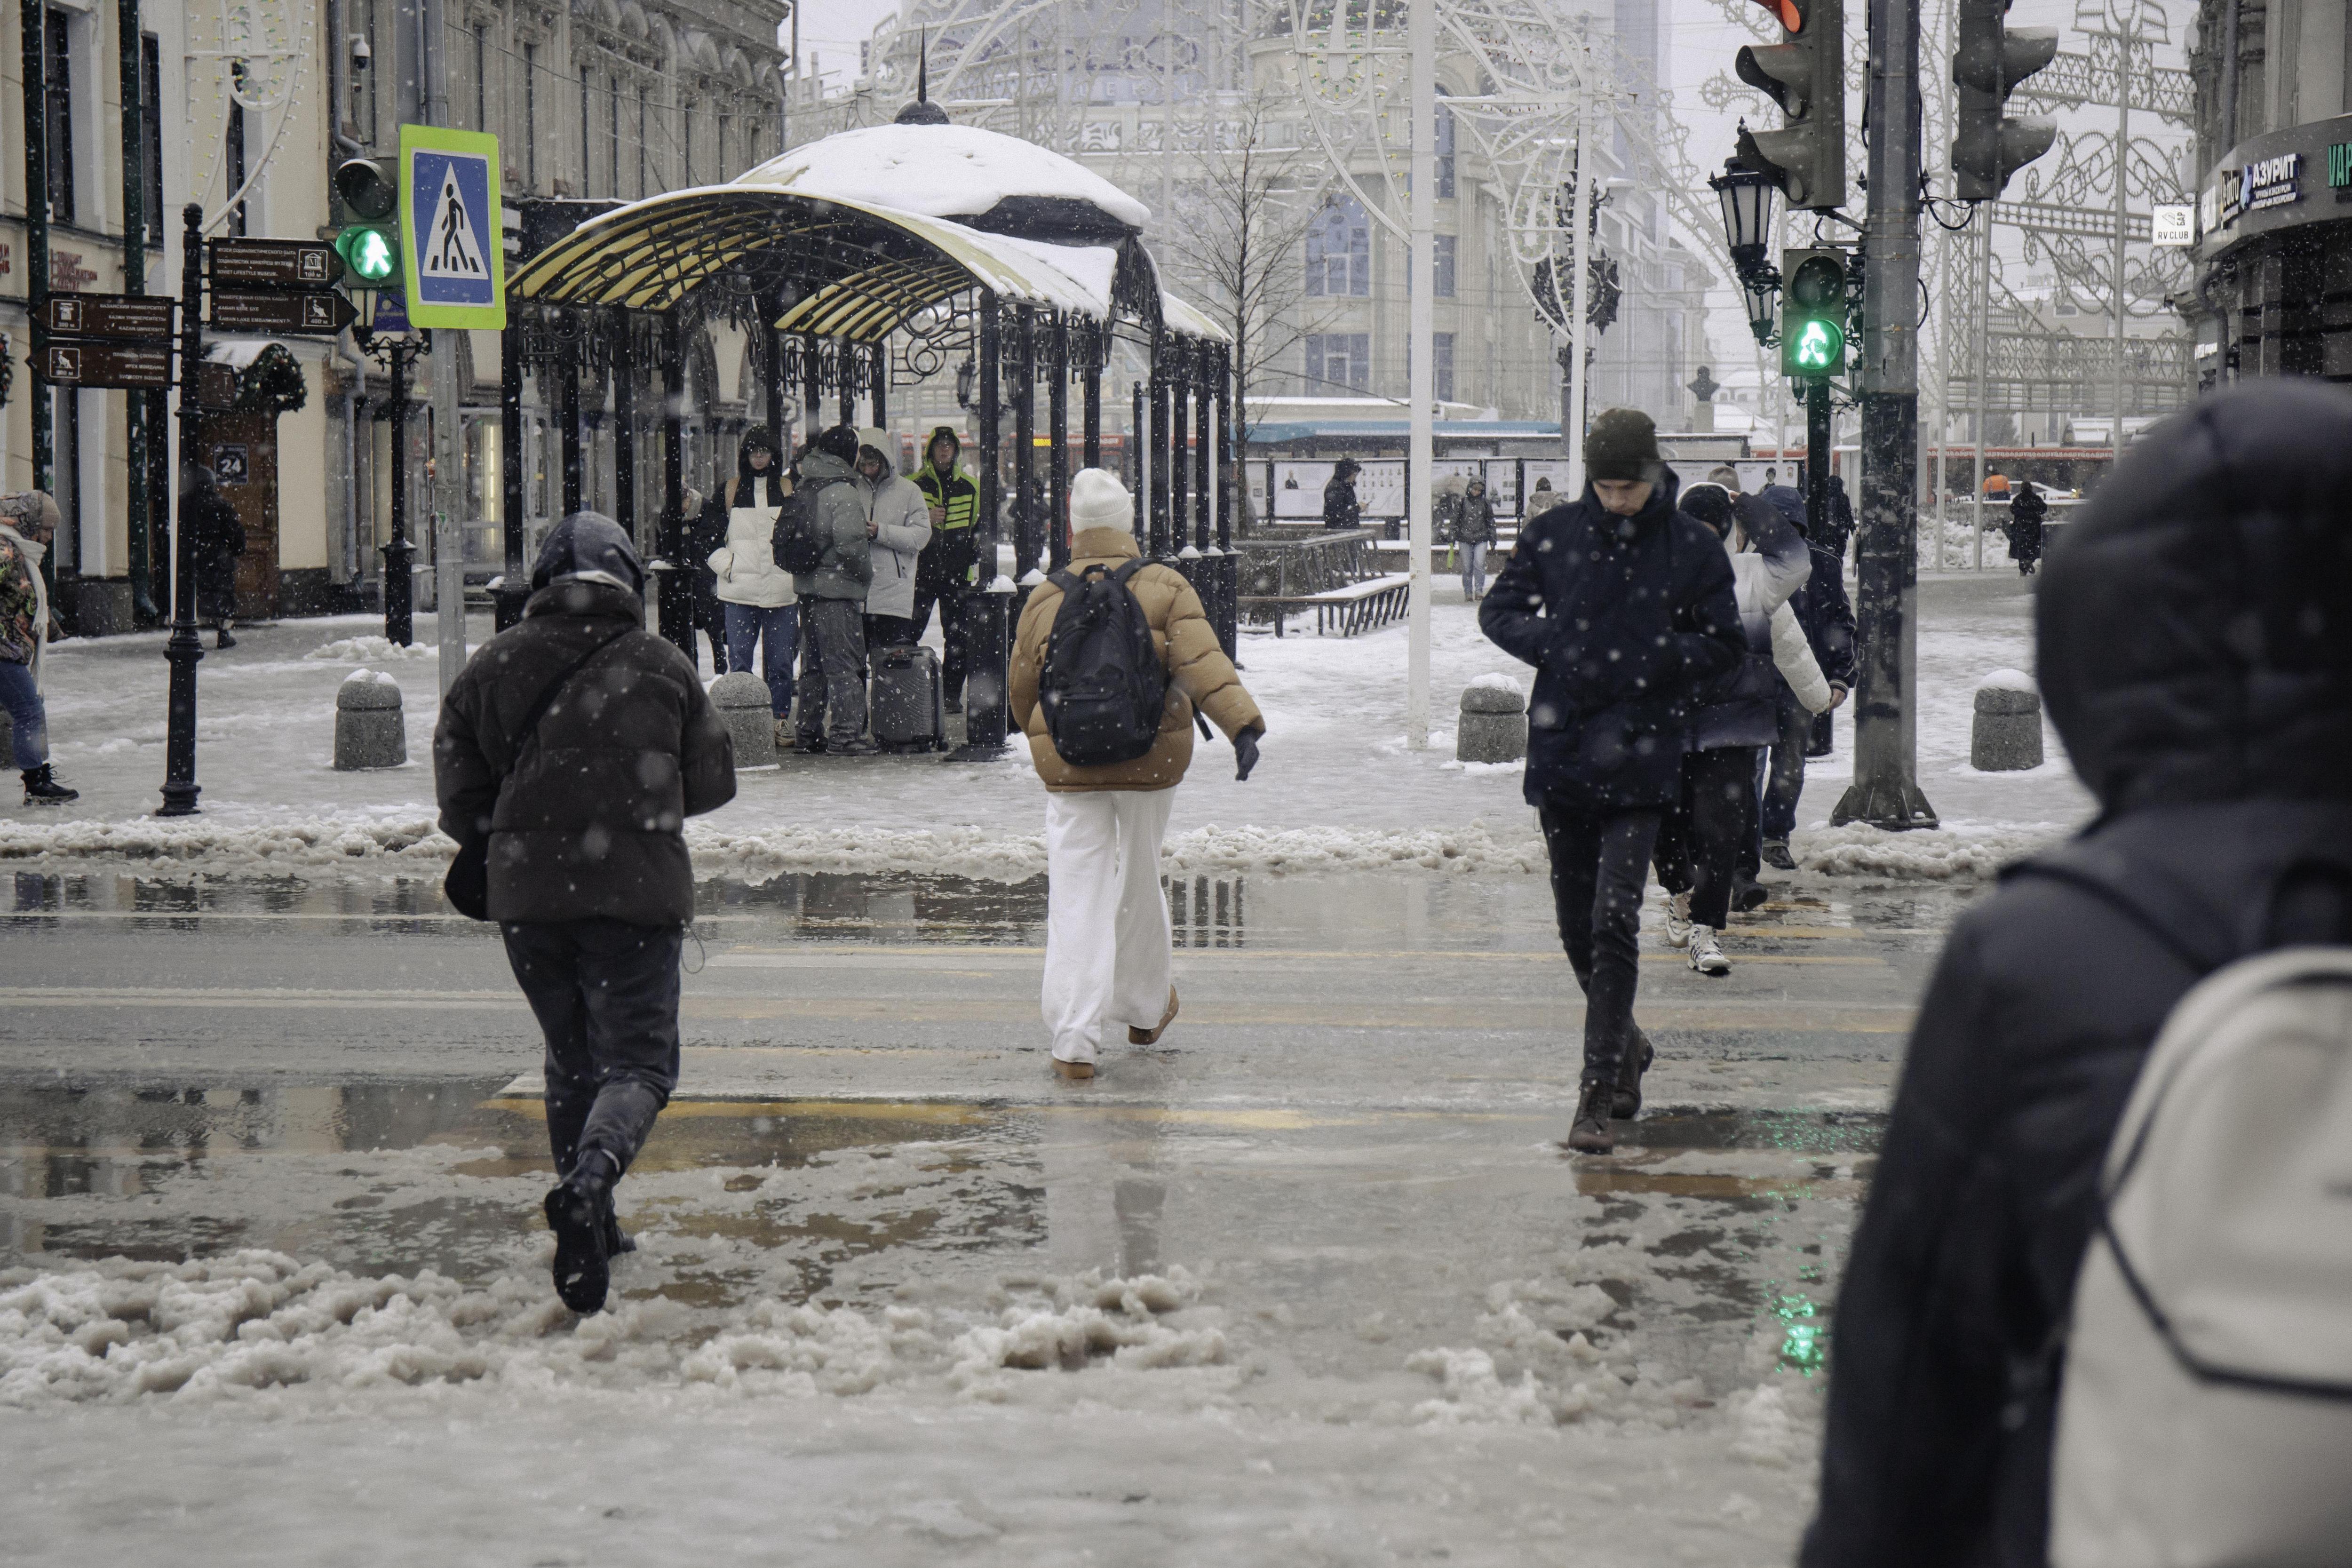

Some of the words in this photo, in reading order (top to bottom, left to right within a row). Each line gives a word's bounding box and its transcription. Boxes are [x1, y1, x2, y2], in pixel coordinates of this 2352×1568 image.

[2252, 153, 2296, 188] АЗУРИТ
[2177, 212, 2185, 226] БАР
[2158, 231, 2168, 239] RV
[2169, 231, 2188, 239] CLUB
[220, 457, 242, 473] 24
